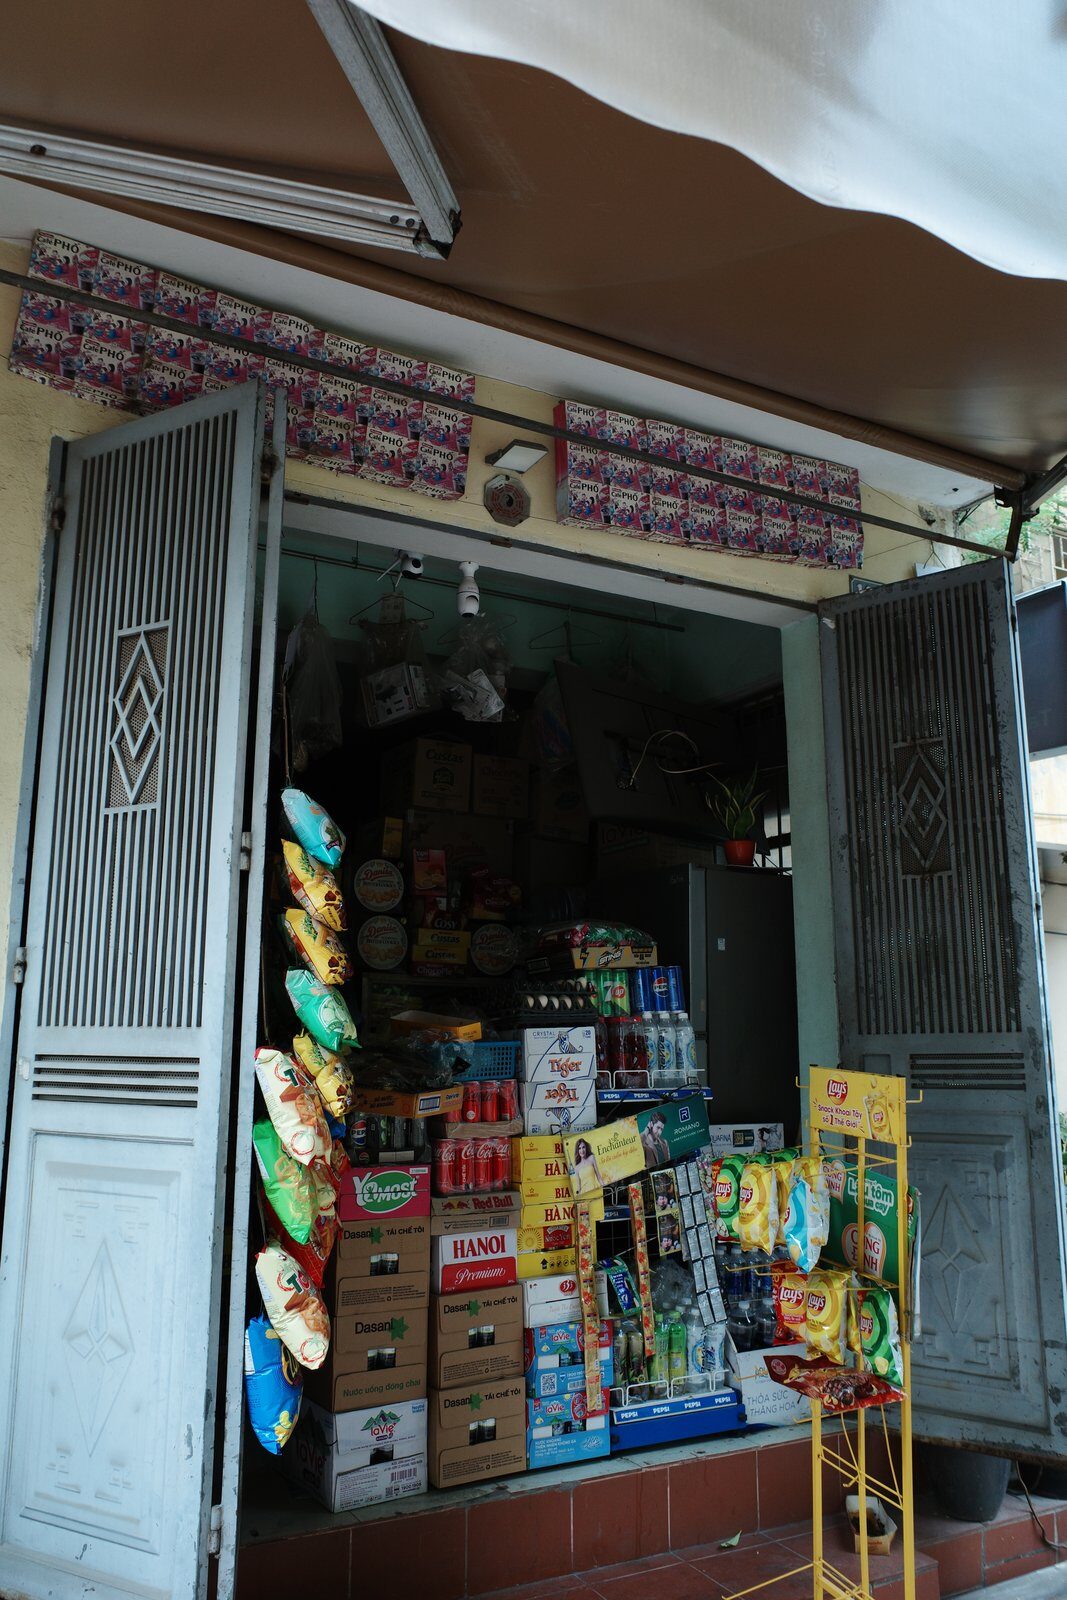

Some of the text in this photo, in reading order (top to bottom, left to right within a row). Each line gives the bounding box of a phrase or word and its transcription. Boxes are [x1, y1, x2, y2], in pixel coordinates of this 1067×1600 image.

[548, 1058, 582, 1078] Tiger
[829, 1080, 848, 1098] Lay's
[674, 1121, 700, 1135] ROMANO
[555, 1143, 564, 1154] BI
[597, 1136, 637, 1155] Enchanteur
[545, 1160, 561, 1176] HÀ
[555, 1187, 571, 1198] BIA
[716, 1183, 731, 1199] Lay's
[472, 1195, 513, 1209] Red Bull
[545, 1204, 561, 1221] HÀ
[453, 1235, 506, 1259] HANOI
[851, 1230, 880, 1255] CNG
[454, 1267, 507, 1285] Premium
[780, 1287, 804, 1303] Lay's
[809, 1293, 825, 1310] Lay's
[620, 1396, 731, 1419] PEPSI PEPSI PEPSI PEPSI
